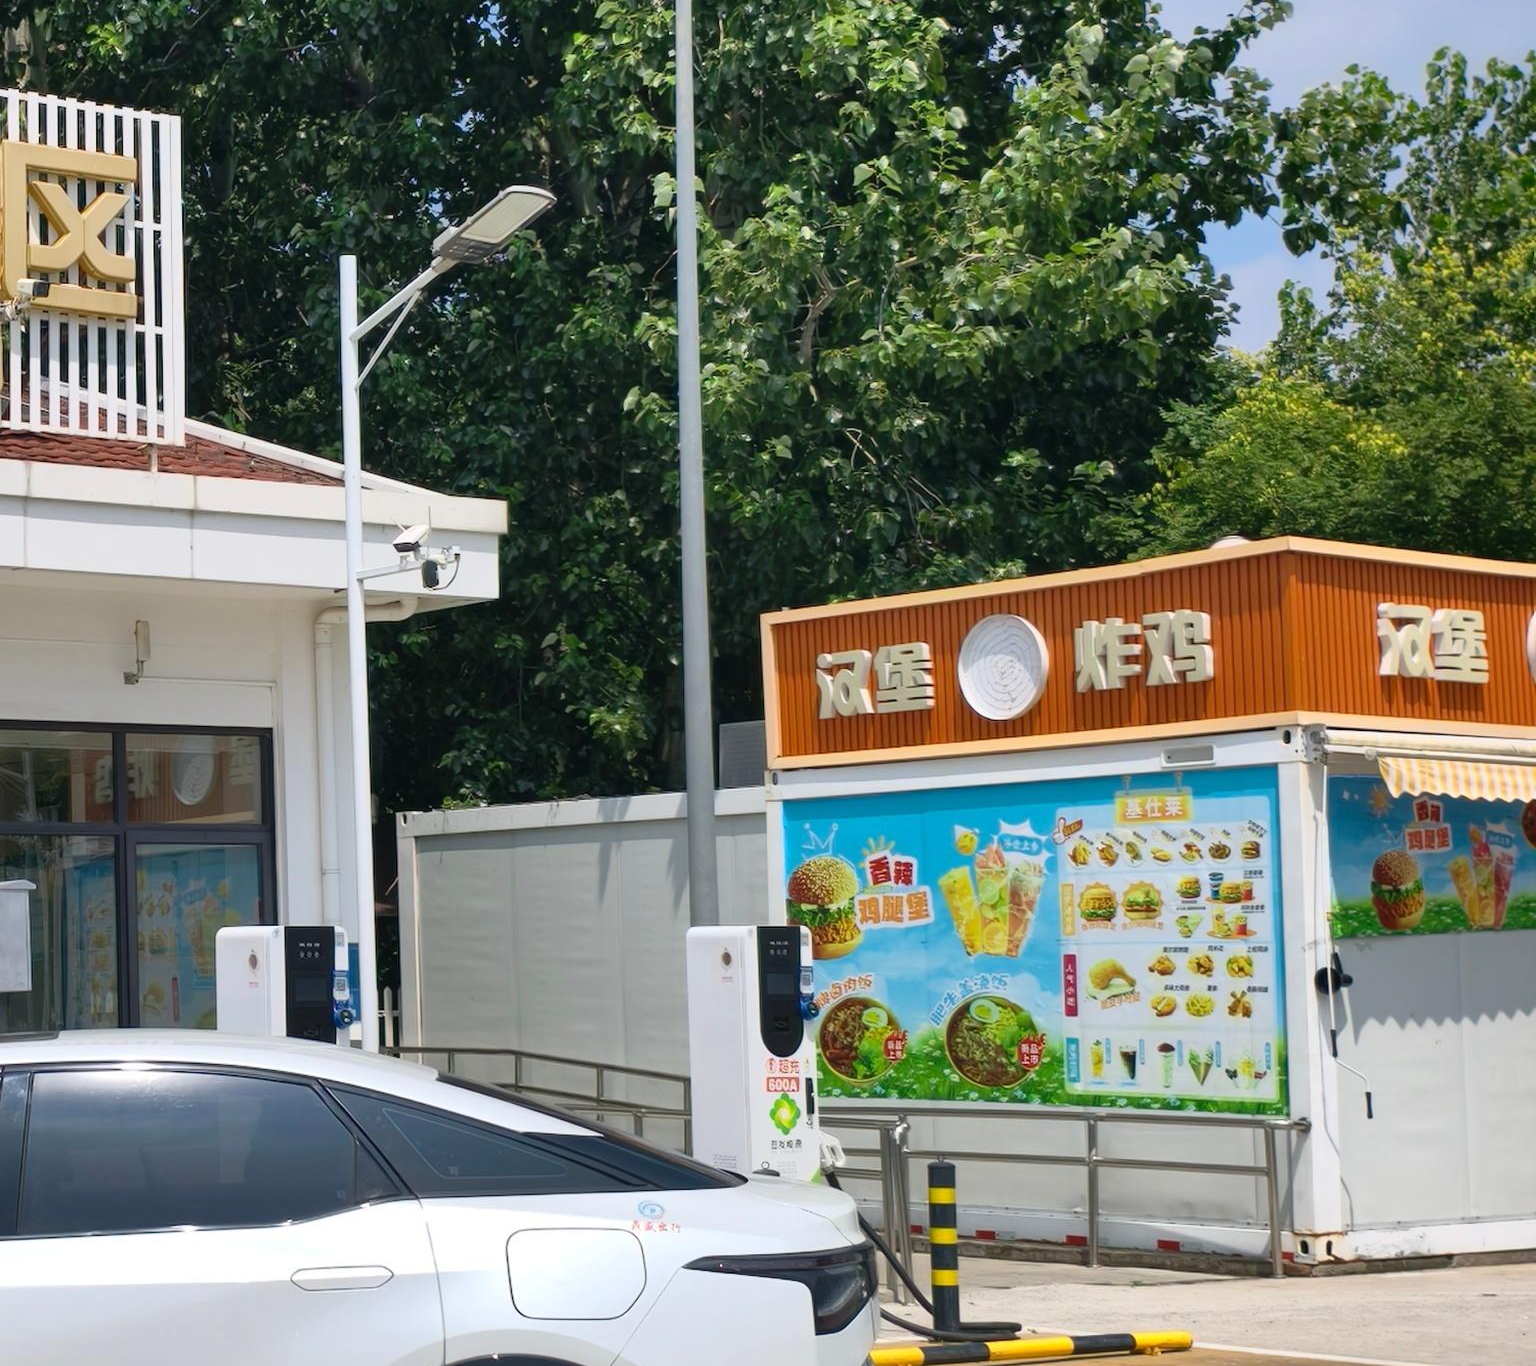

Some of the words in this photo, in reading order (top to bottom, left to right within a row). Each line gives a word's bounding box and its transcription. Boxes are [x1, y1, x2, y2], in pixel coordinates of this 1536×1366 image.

[1376, 602, 1489, 683] 汉堡
[816, 641, 935, 719] 汉堡
[1074, 609, 1215, 693] 炸鸡
[868, 855, 914, 887] 香辣
[858, 890, 931, 925] 鸡腿堡
[768, 1078, 798, 1092] 600A
